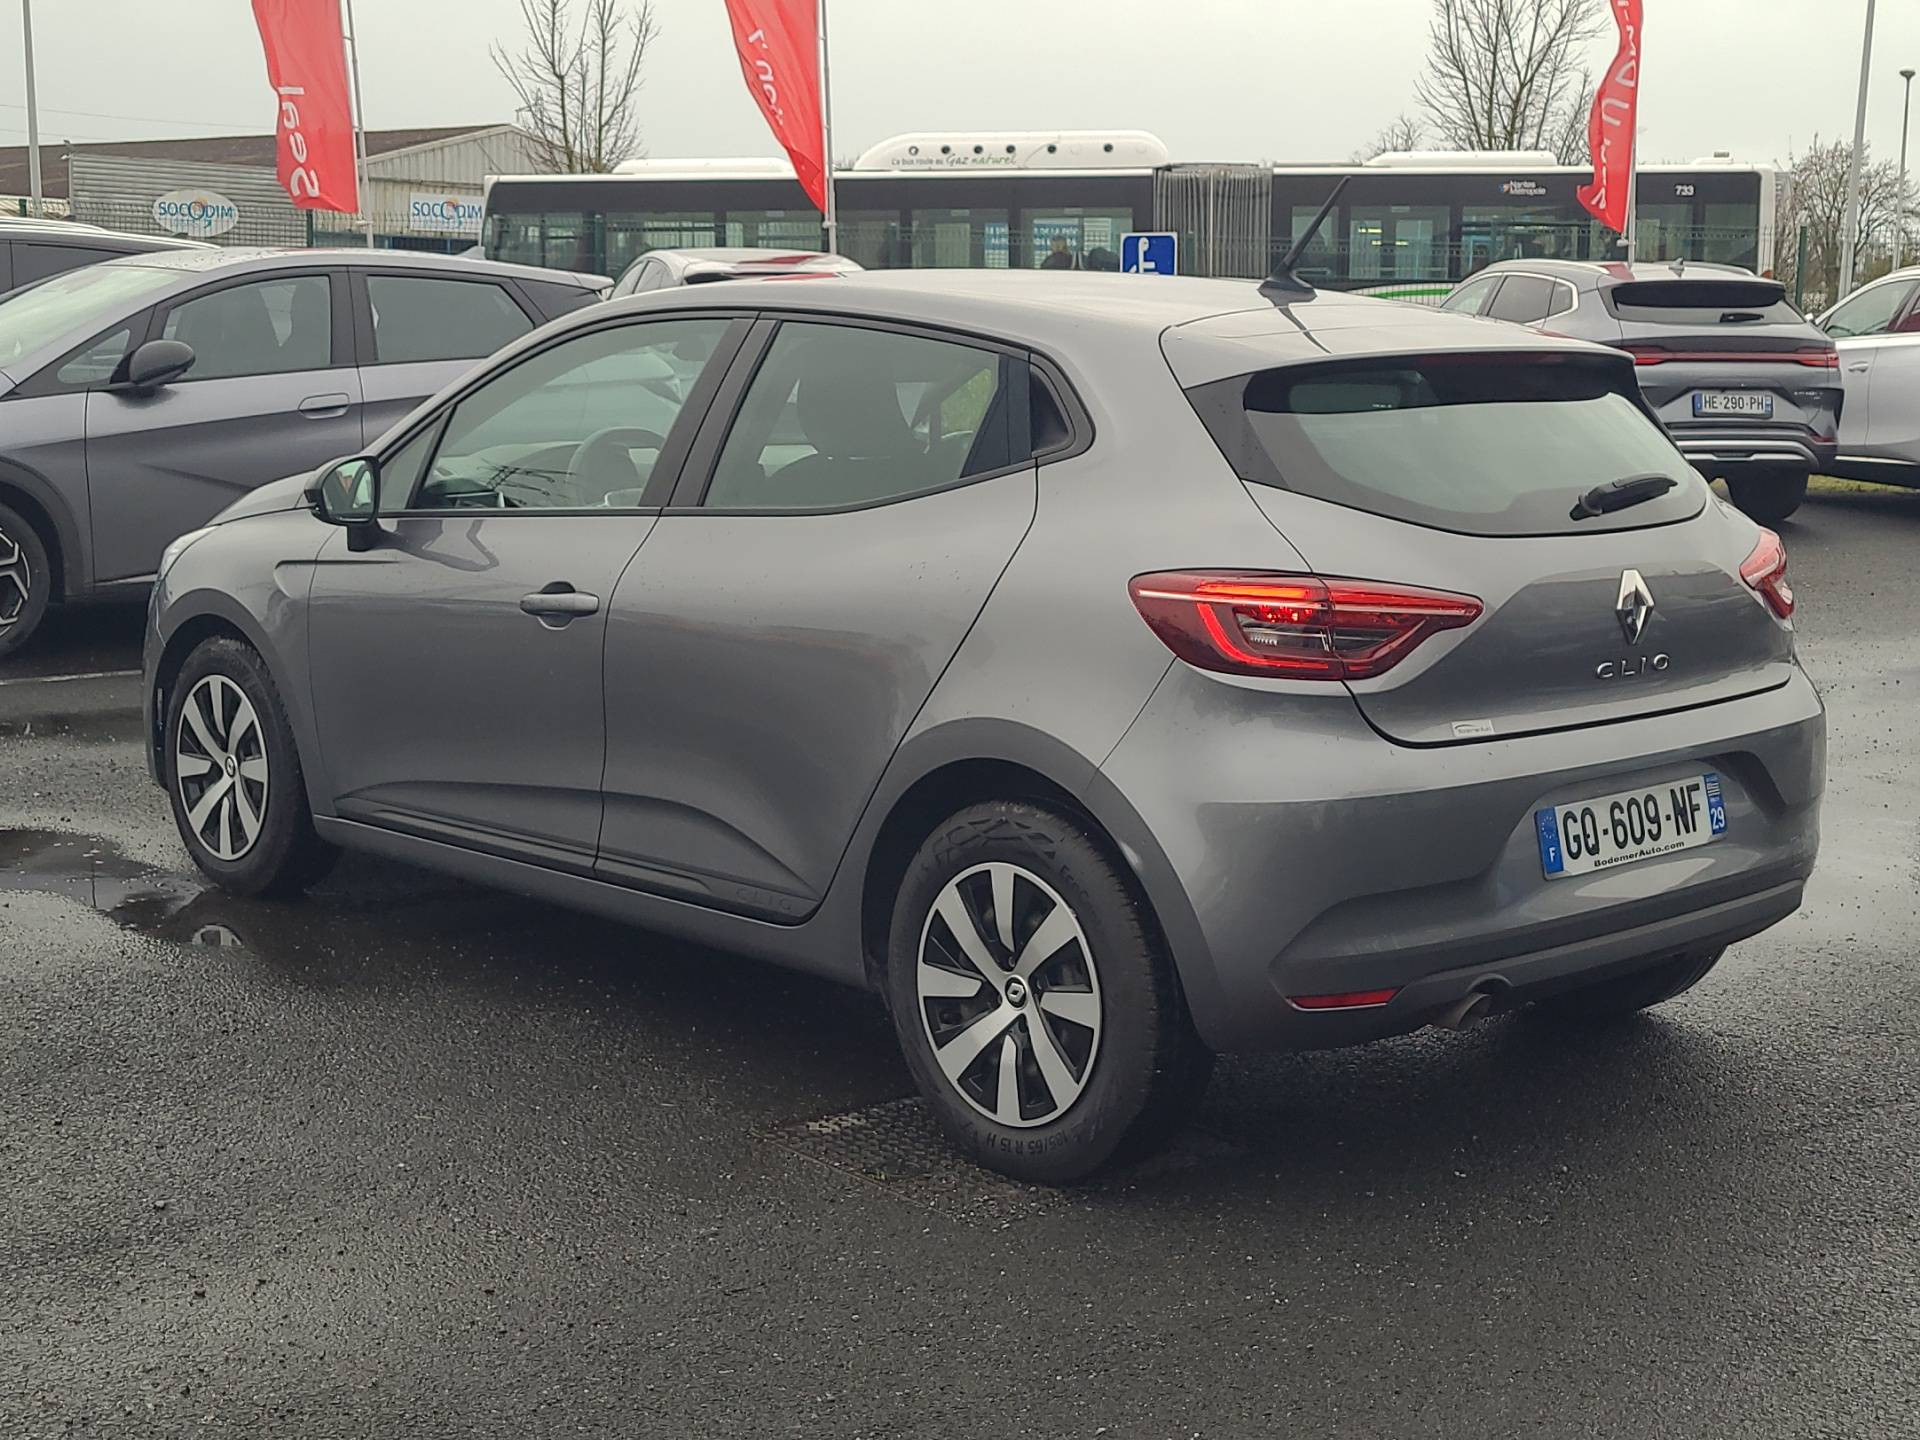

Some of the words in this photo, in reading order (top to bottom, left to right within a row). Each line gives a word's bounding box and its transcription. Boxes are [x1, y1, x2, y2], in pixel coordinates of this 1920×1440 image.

[1675, 184, 1695, 196] 733
[158, 201, 233, 220] SOCODIM
[412, 201, 482, 220] SOCODIM
[1703, 395, 1764, 411] HE-290-PH
[1597, 653, 1669, 678] CLIO
[1562, 782, 1700, 860] GQ-609-NF
[1710, 806, 1725, 830] 29
[1549, 847, 1556, 862] F
[1593, 840, 1685, 868] BodemerAuto.com
